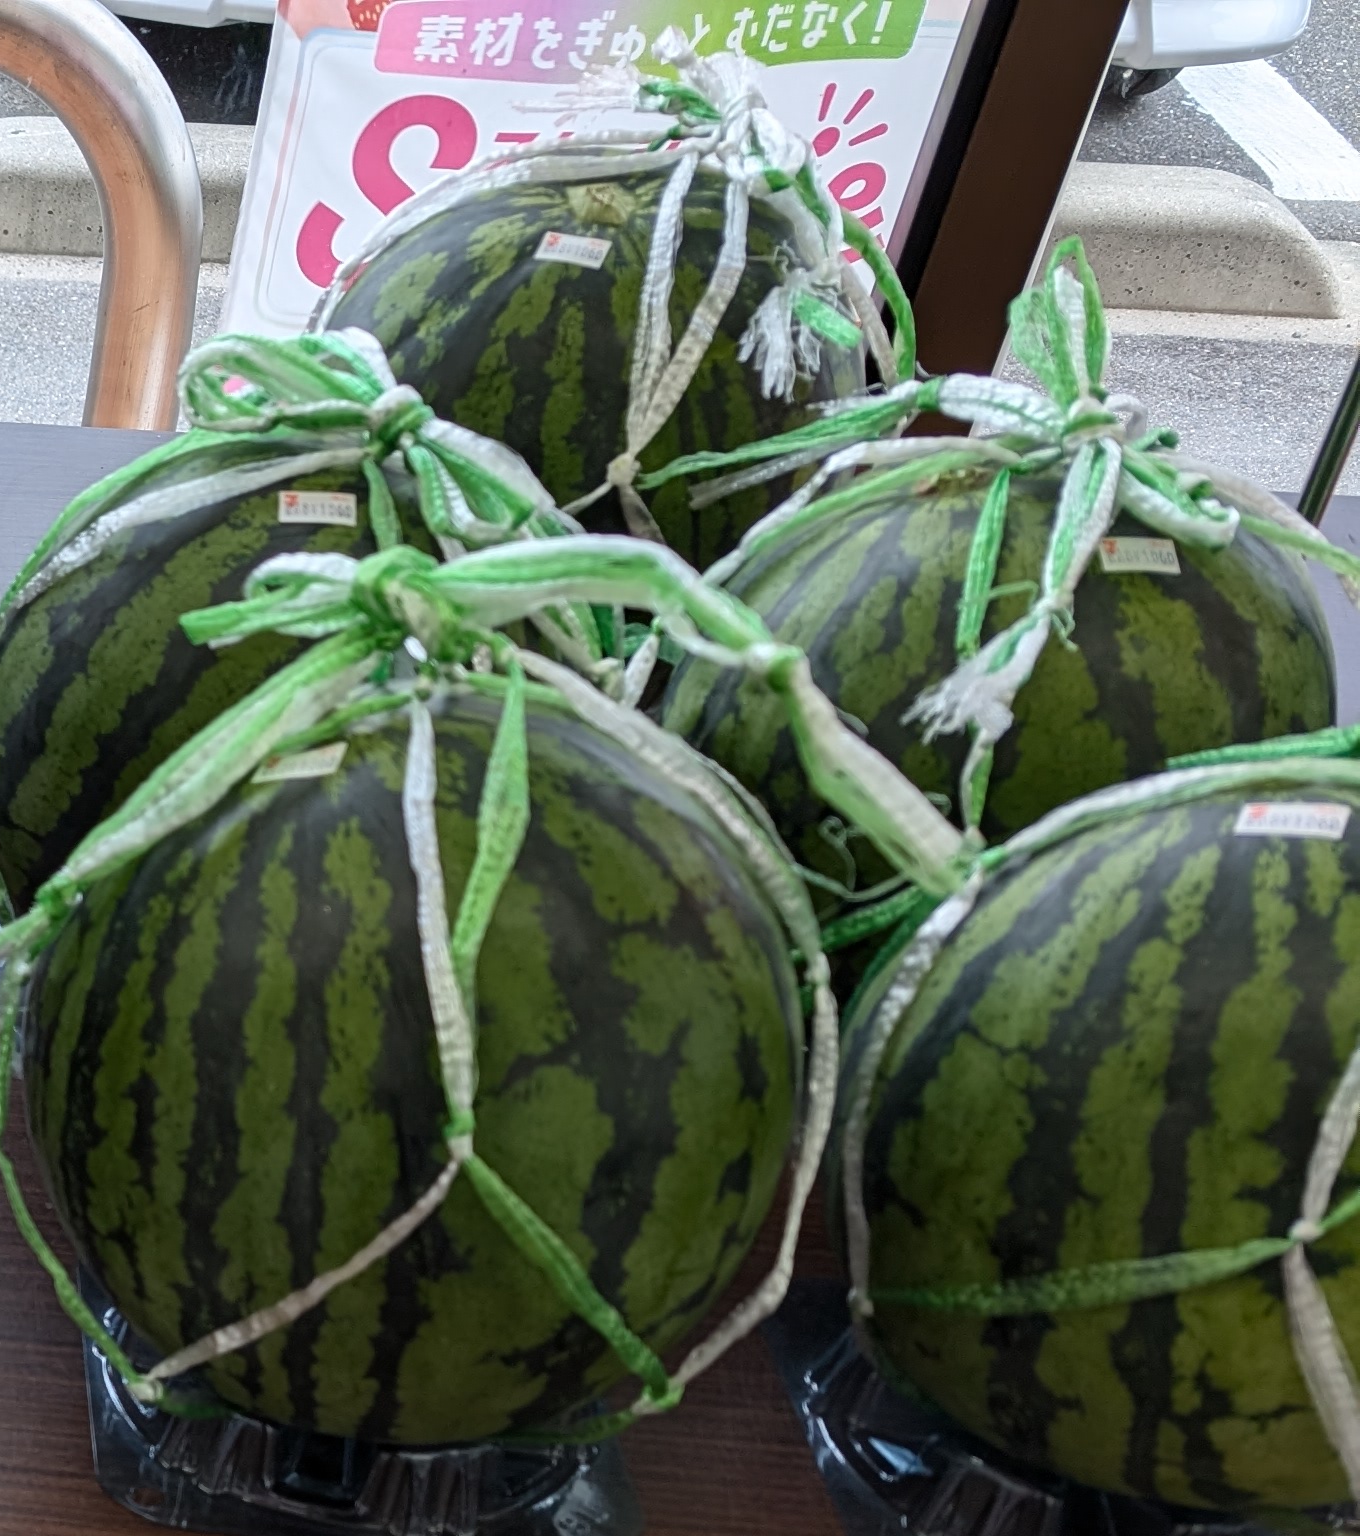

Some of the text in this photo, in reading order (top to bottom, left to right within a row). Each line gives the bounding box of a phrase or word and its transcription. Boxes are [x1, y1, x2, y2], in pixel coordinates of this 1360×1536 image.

[412, 1, 887, 70] 素材をぎゅとむだなく!
